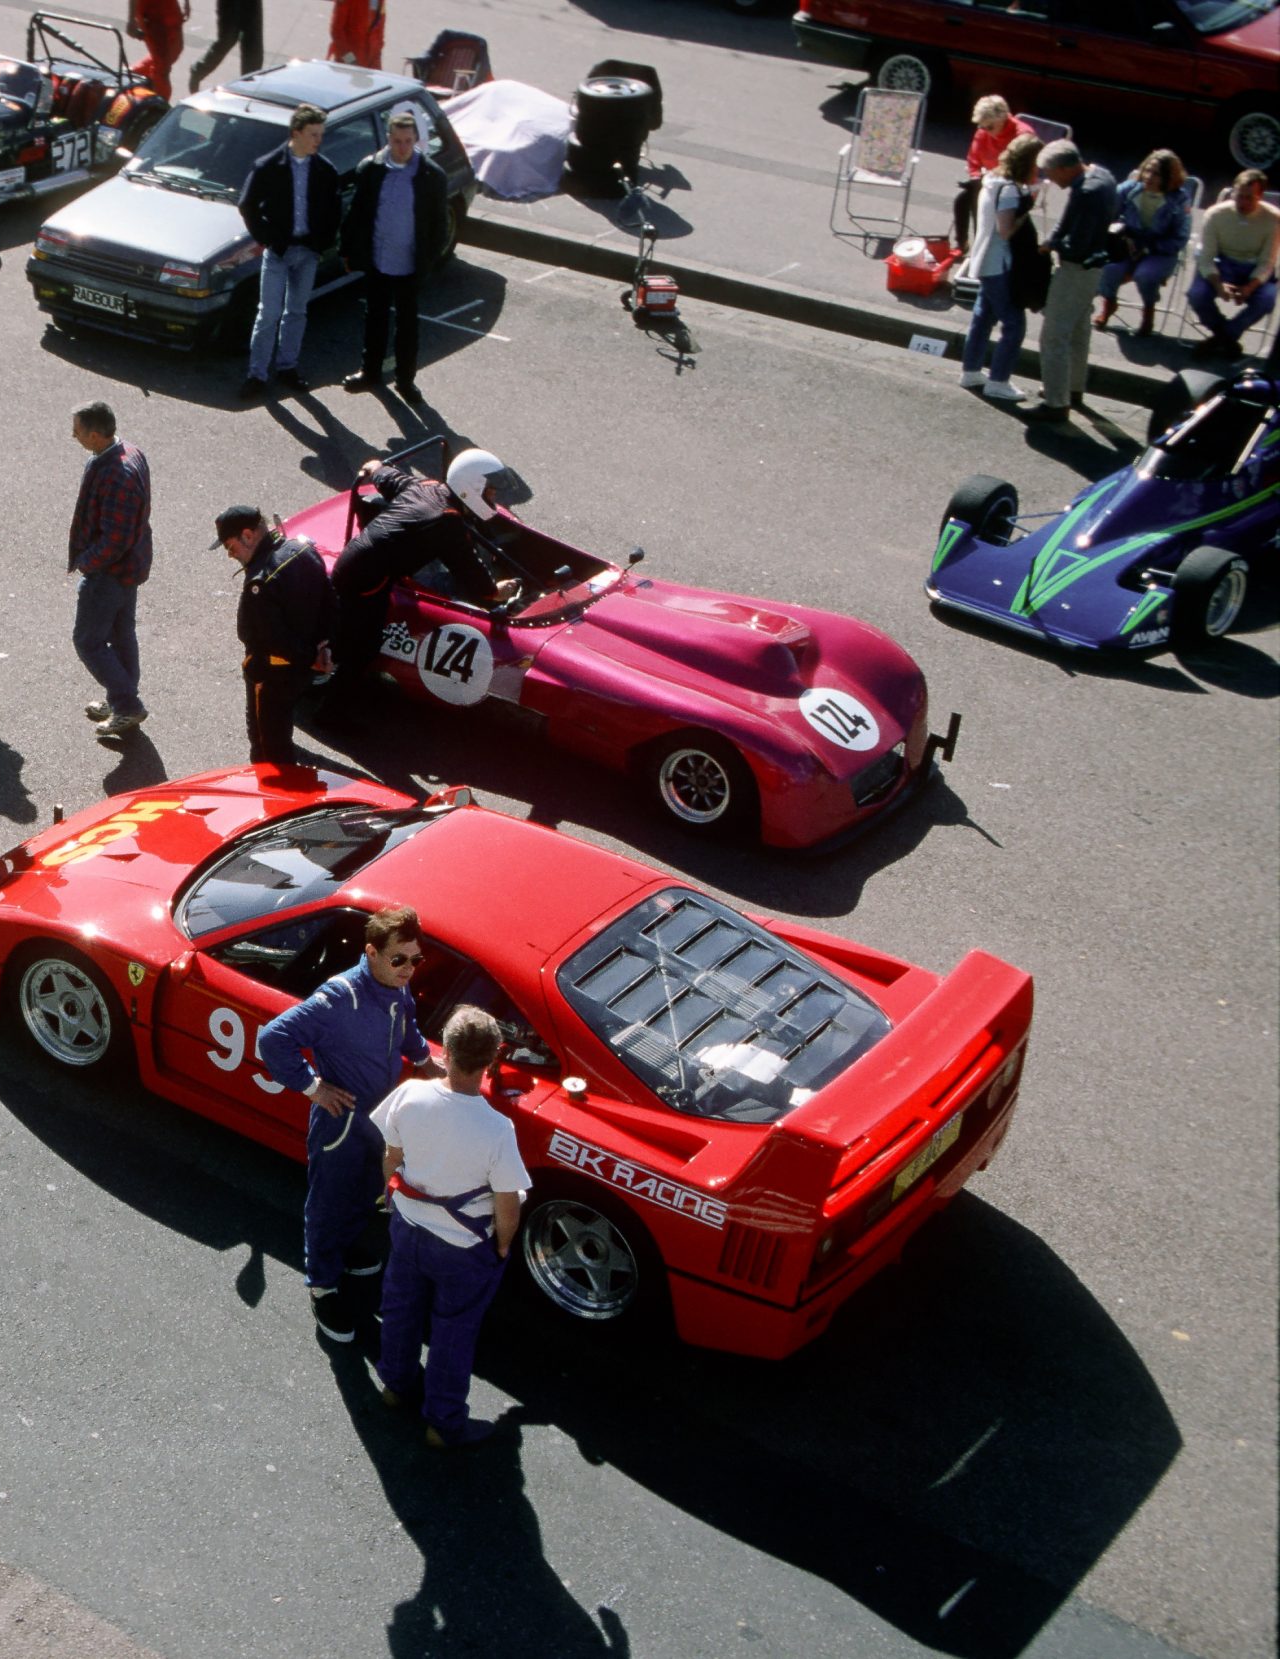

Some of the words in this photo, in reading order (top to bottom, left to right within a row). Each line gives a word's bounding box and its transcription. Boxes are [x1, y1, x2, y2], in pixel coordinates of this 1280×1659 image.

[51, 131, 92, 173] 272
[423, 625, 480, 684] 124
[808, 697, 872, 745] 124
[41, 800, 184, 867] HCS
[548, 1134, 607, 1177] BK
[611, 1161, 728, 1226] RACING
